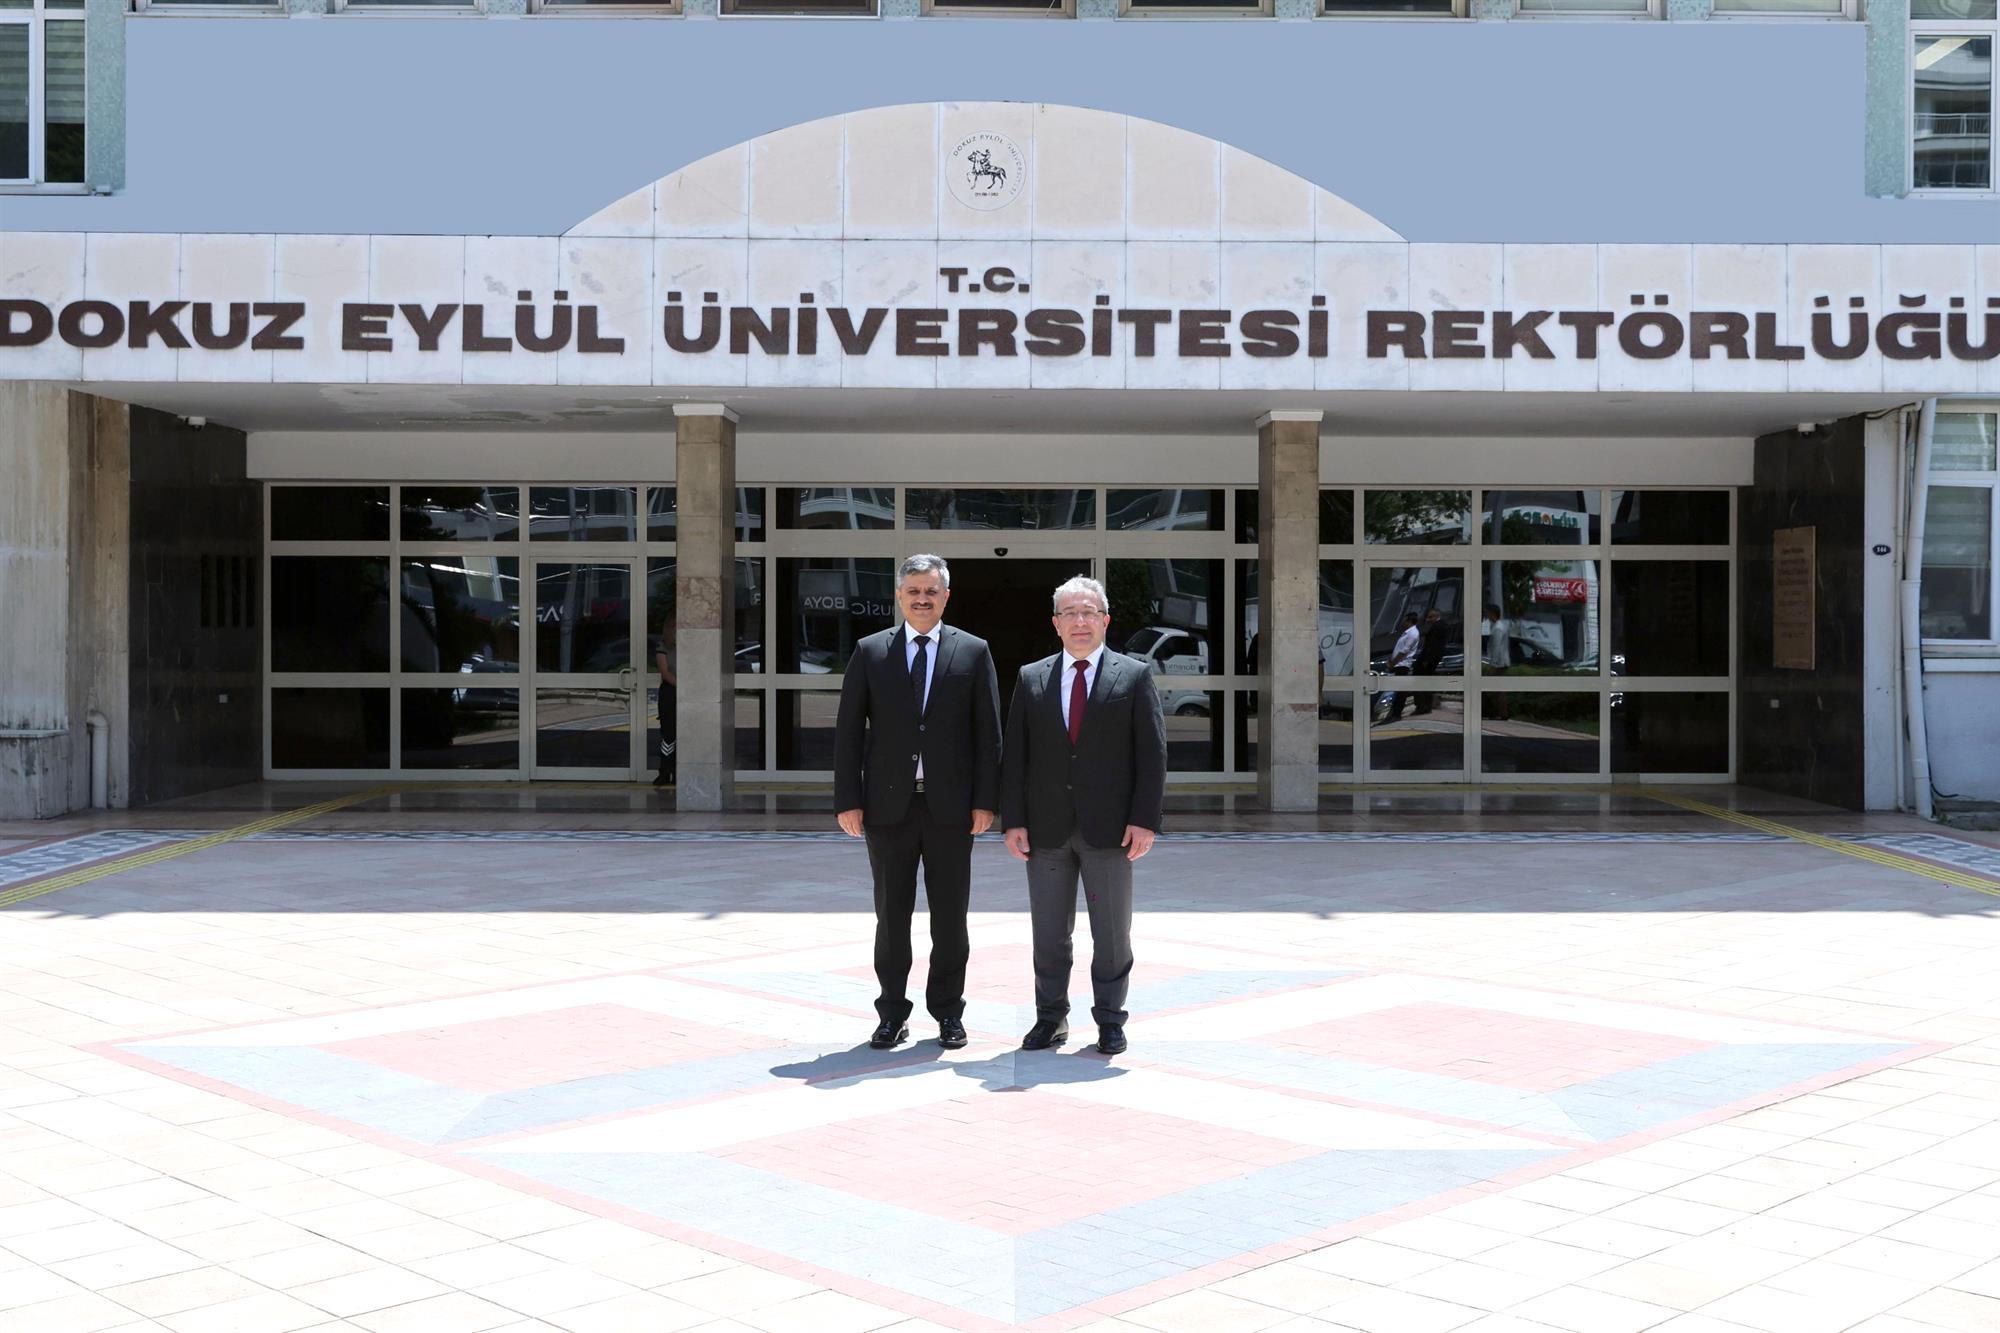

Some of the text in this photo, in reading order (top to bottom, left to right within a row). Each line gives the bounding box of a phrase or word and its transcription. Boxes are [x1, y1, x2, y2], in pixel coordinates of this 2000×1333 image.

[953, 136, 976, 156] DOKUZ
[940, 267, 1029, 293] T.C.
[0, 290, 2000, 361] DOKUZ EYLÜL ÜNİVERSİTESİ REKTÖRLÜĞÜ
